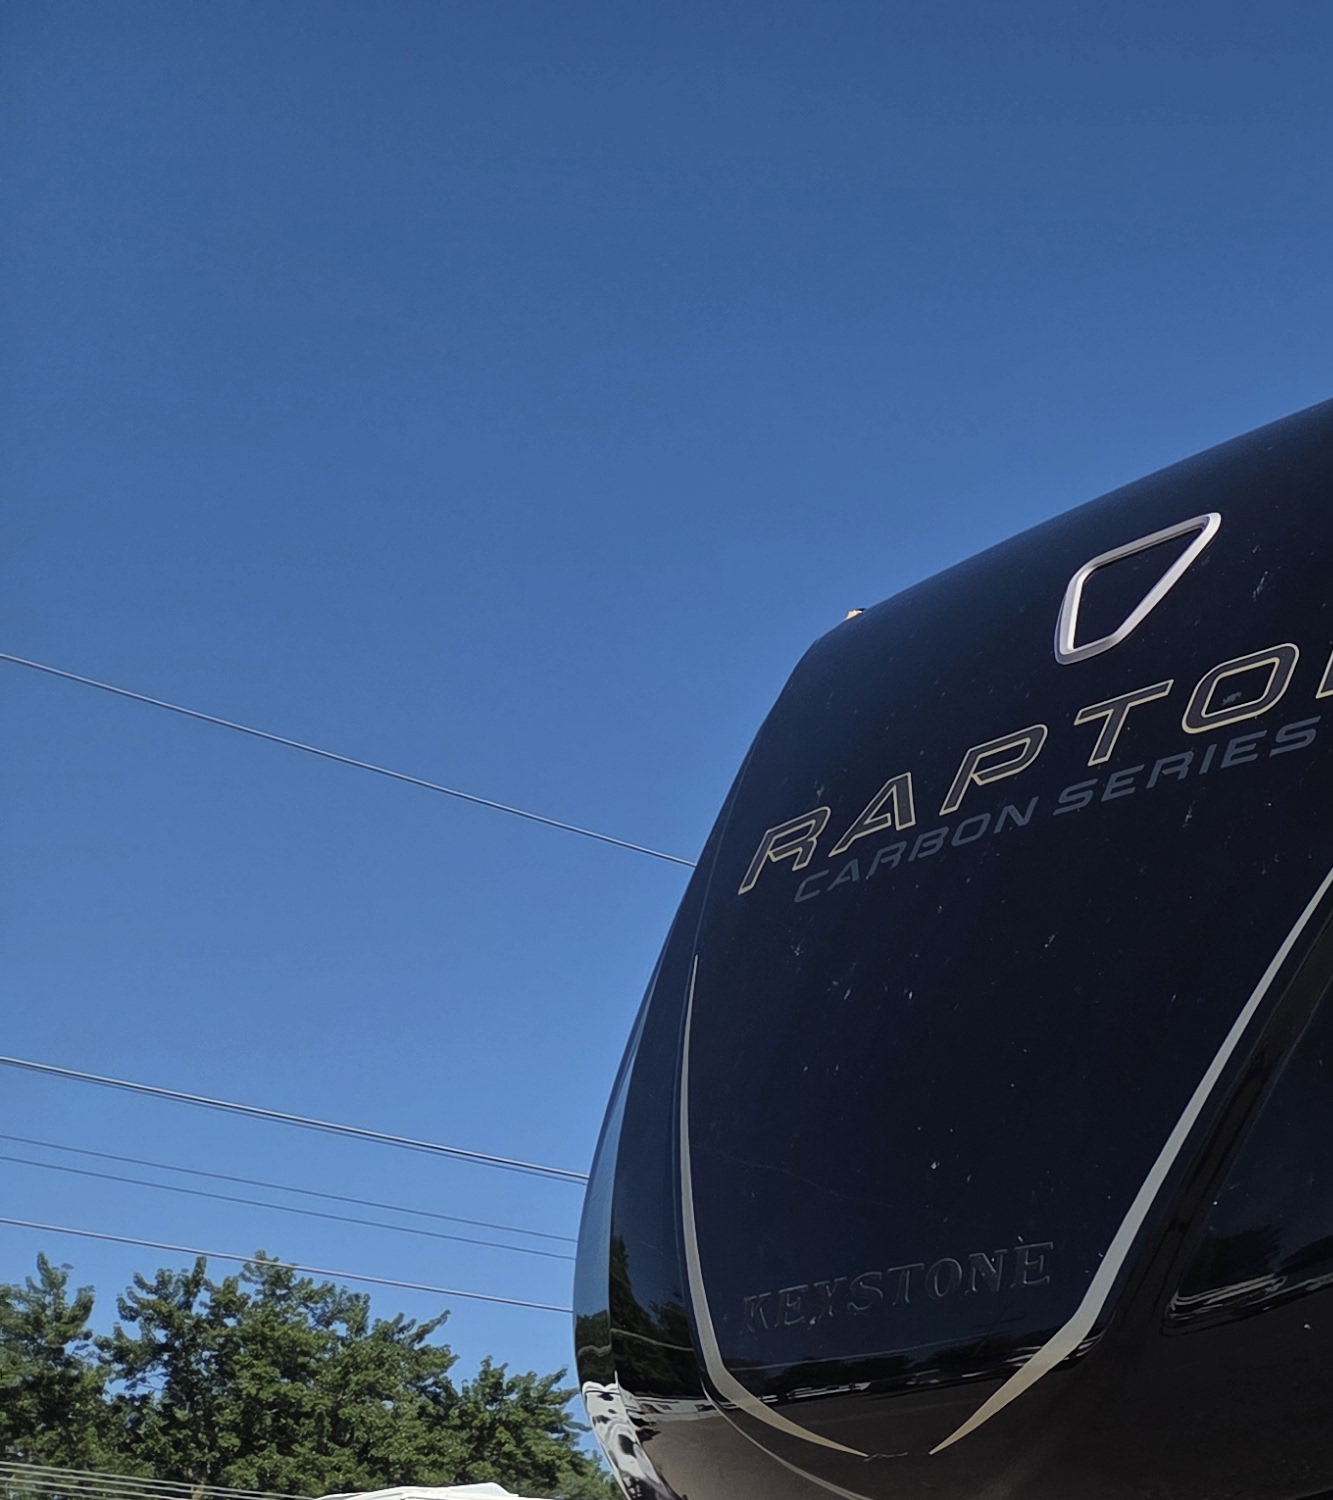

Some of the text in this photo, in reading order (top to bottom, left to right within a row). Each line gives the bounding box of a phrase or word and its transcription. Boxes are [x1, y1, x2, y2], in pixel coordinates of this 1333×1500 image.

[794, 716, 1322, 903] CARBON SERIES
[739, 1241, 1054, 1335] KEYSTONE
